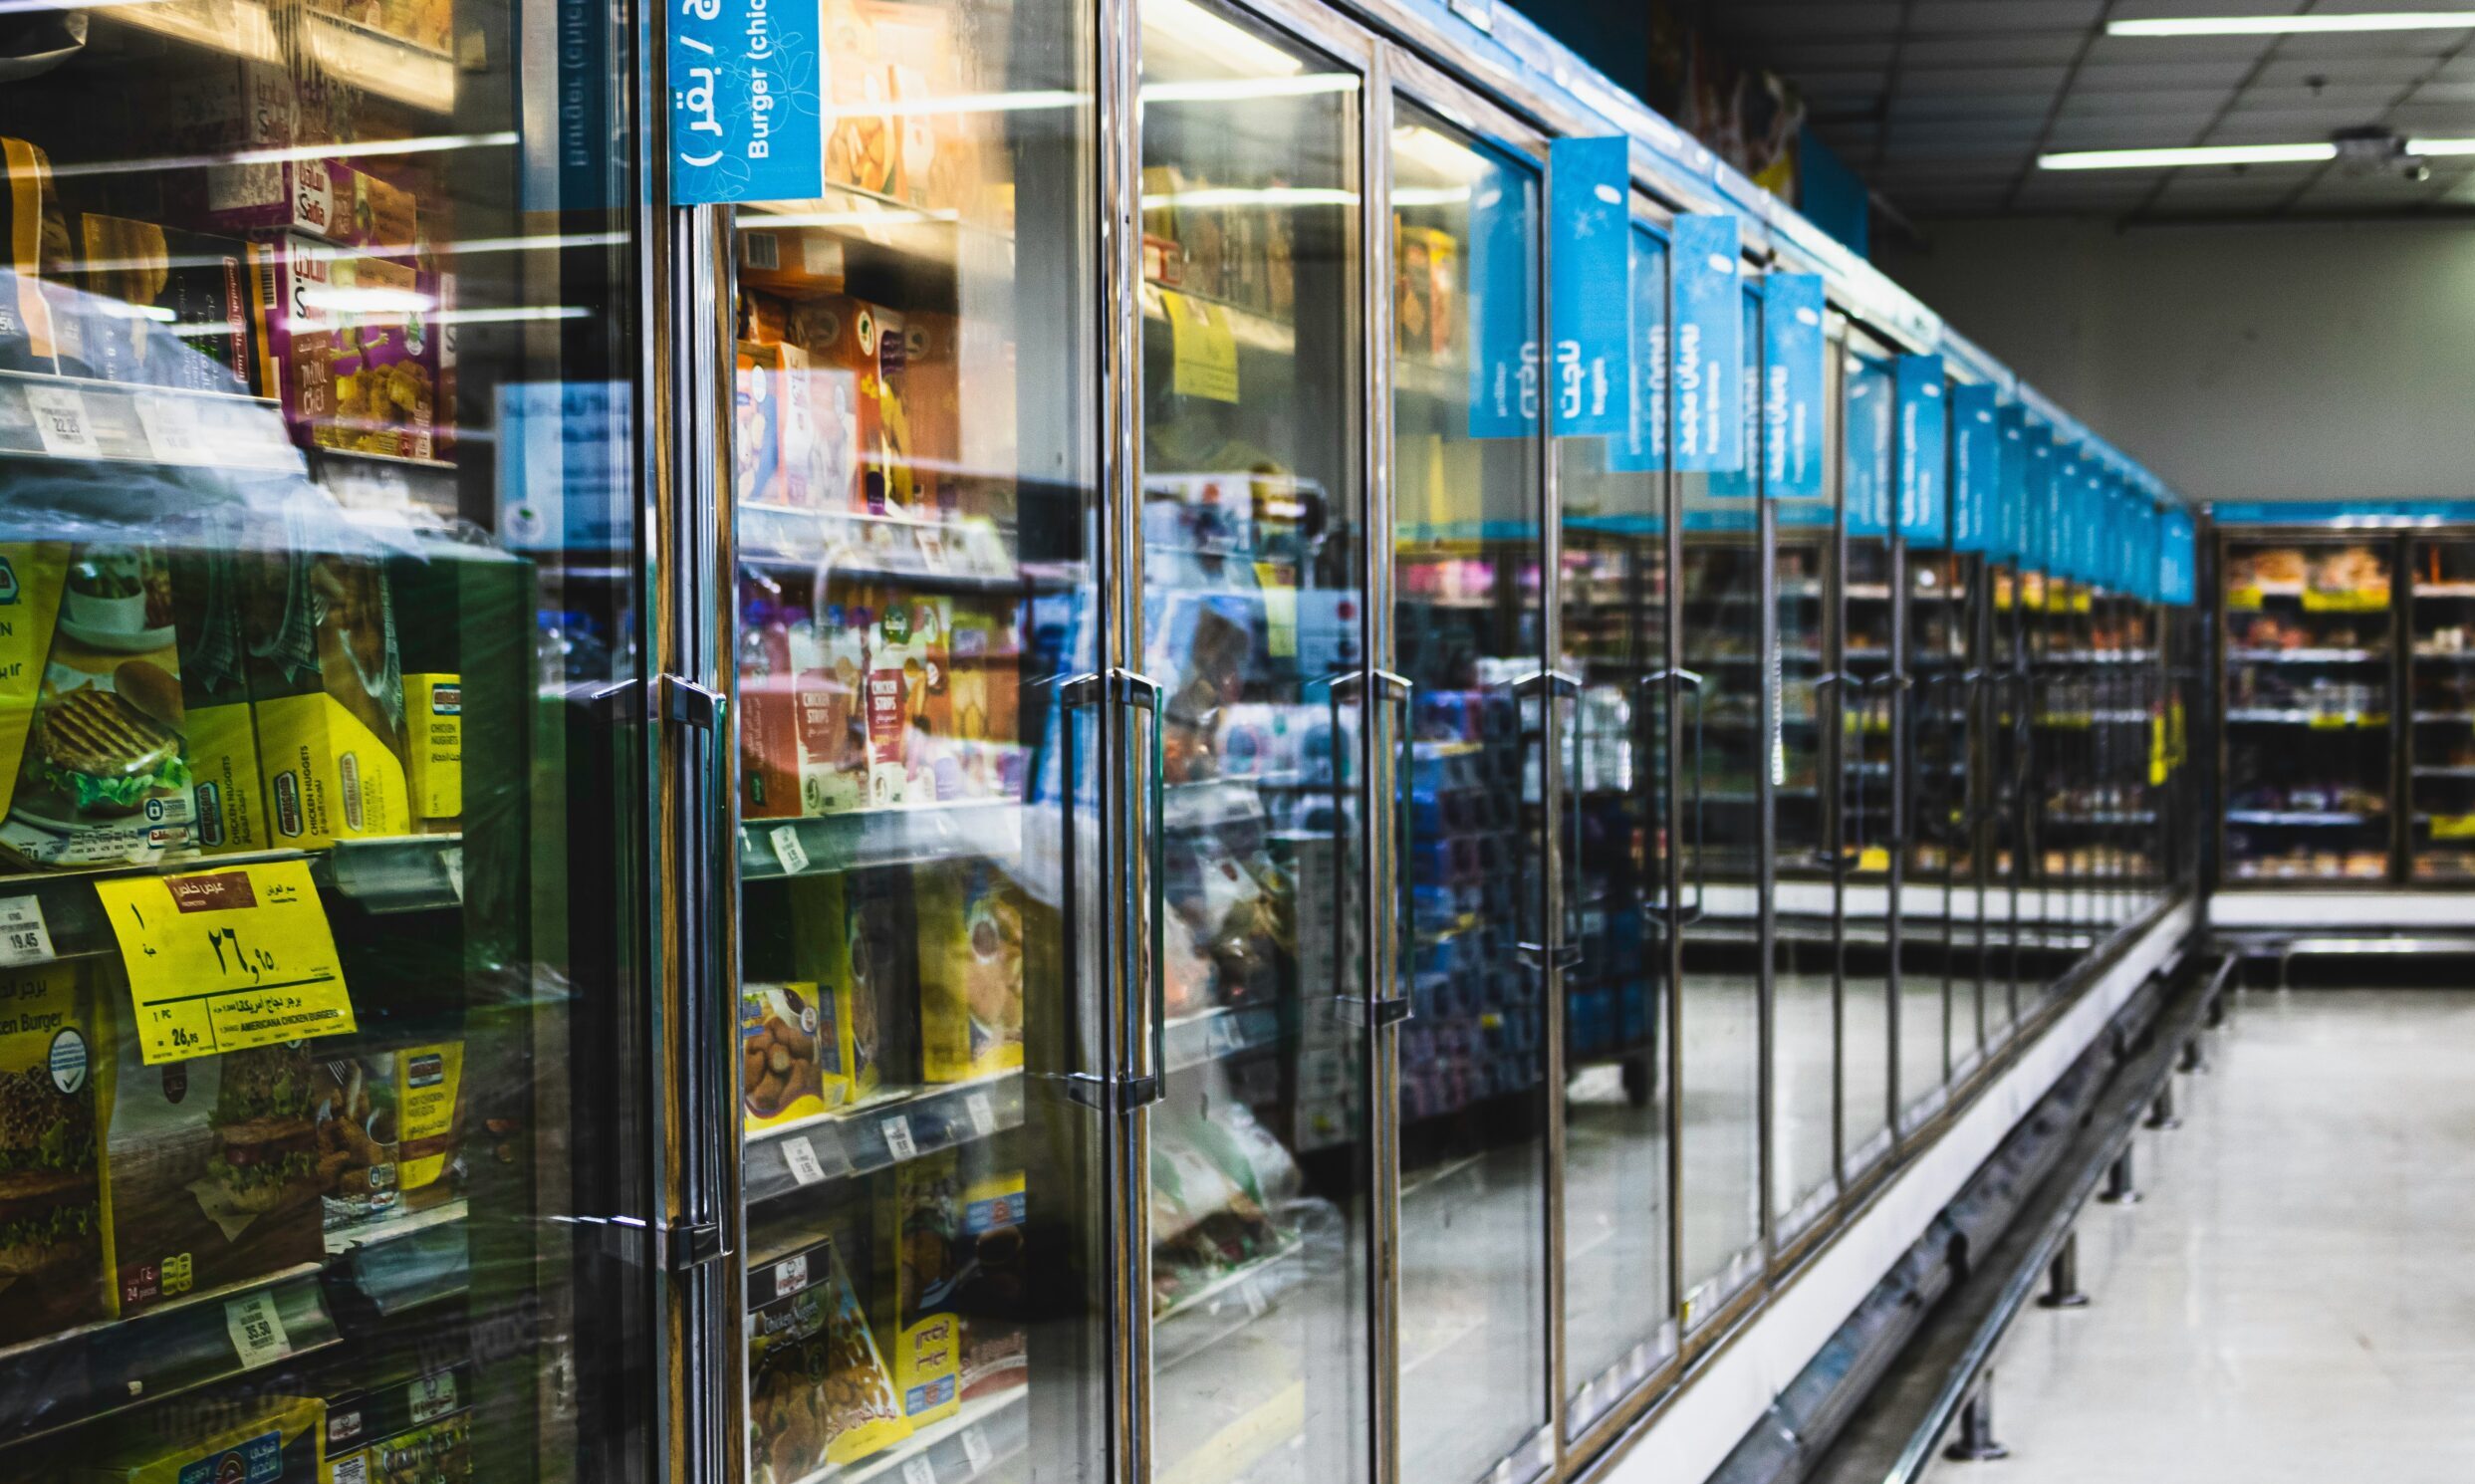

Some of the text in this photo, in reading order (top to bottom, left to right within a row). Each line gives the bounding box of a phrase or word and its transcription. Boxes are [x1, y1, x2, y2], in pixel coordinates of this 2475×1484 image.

[676, 67, 723, 136] بقر
[747, 67, 774, 159] Burger
[221, 755, 240, 845] CHICKEN NUGGETS
[300, 745, 319, 837] CHICKEN NUGGETS
[172, 881, 225, 897] عرض خاص
[10, 932, 39, 948] 19.45
[21, 1012, 64, 1034] Burger
[240, 1018, 282, 1033] AMERICANA
[282, 1014, 310, 1027] CHICKEN
[309, 1008, 340, 1023] BURGERS
[126, 1287, 138, 1302] 24
